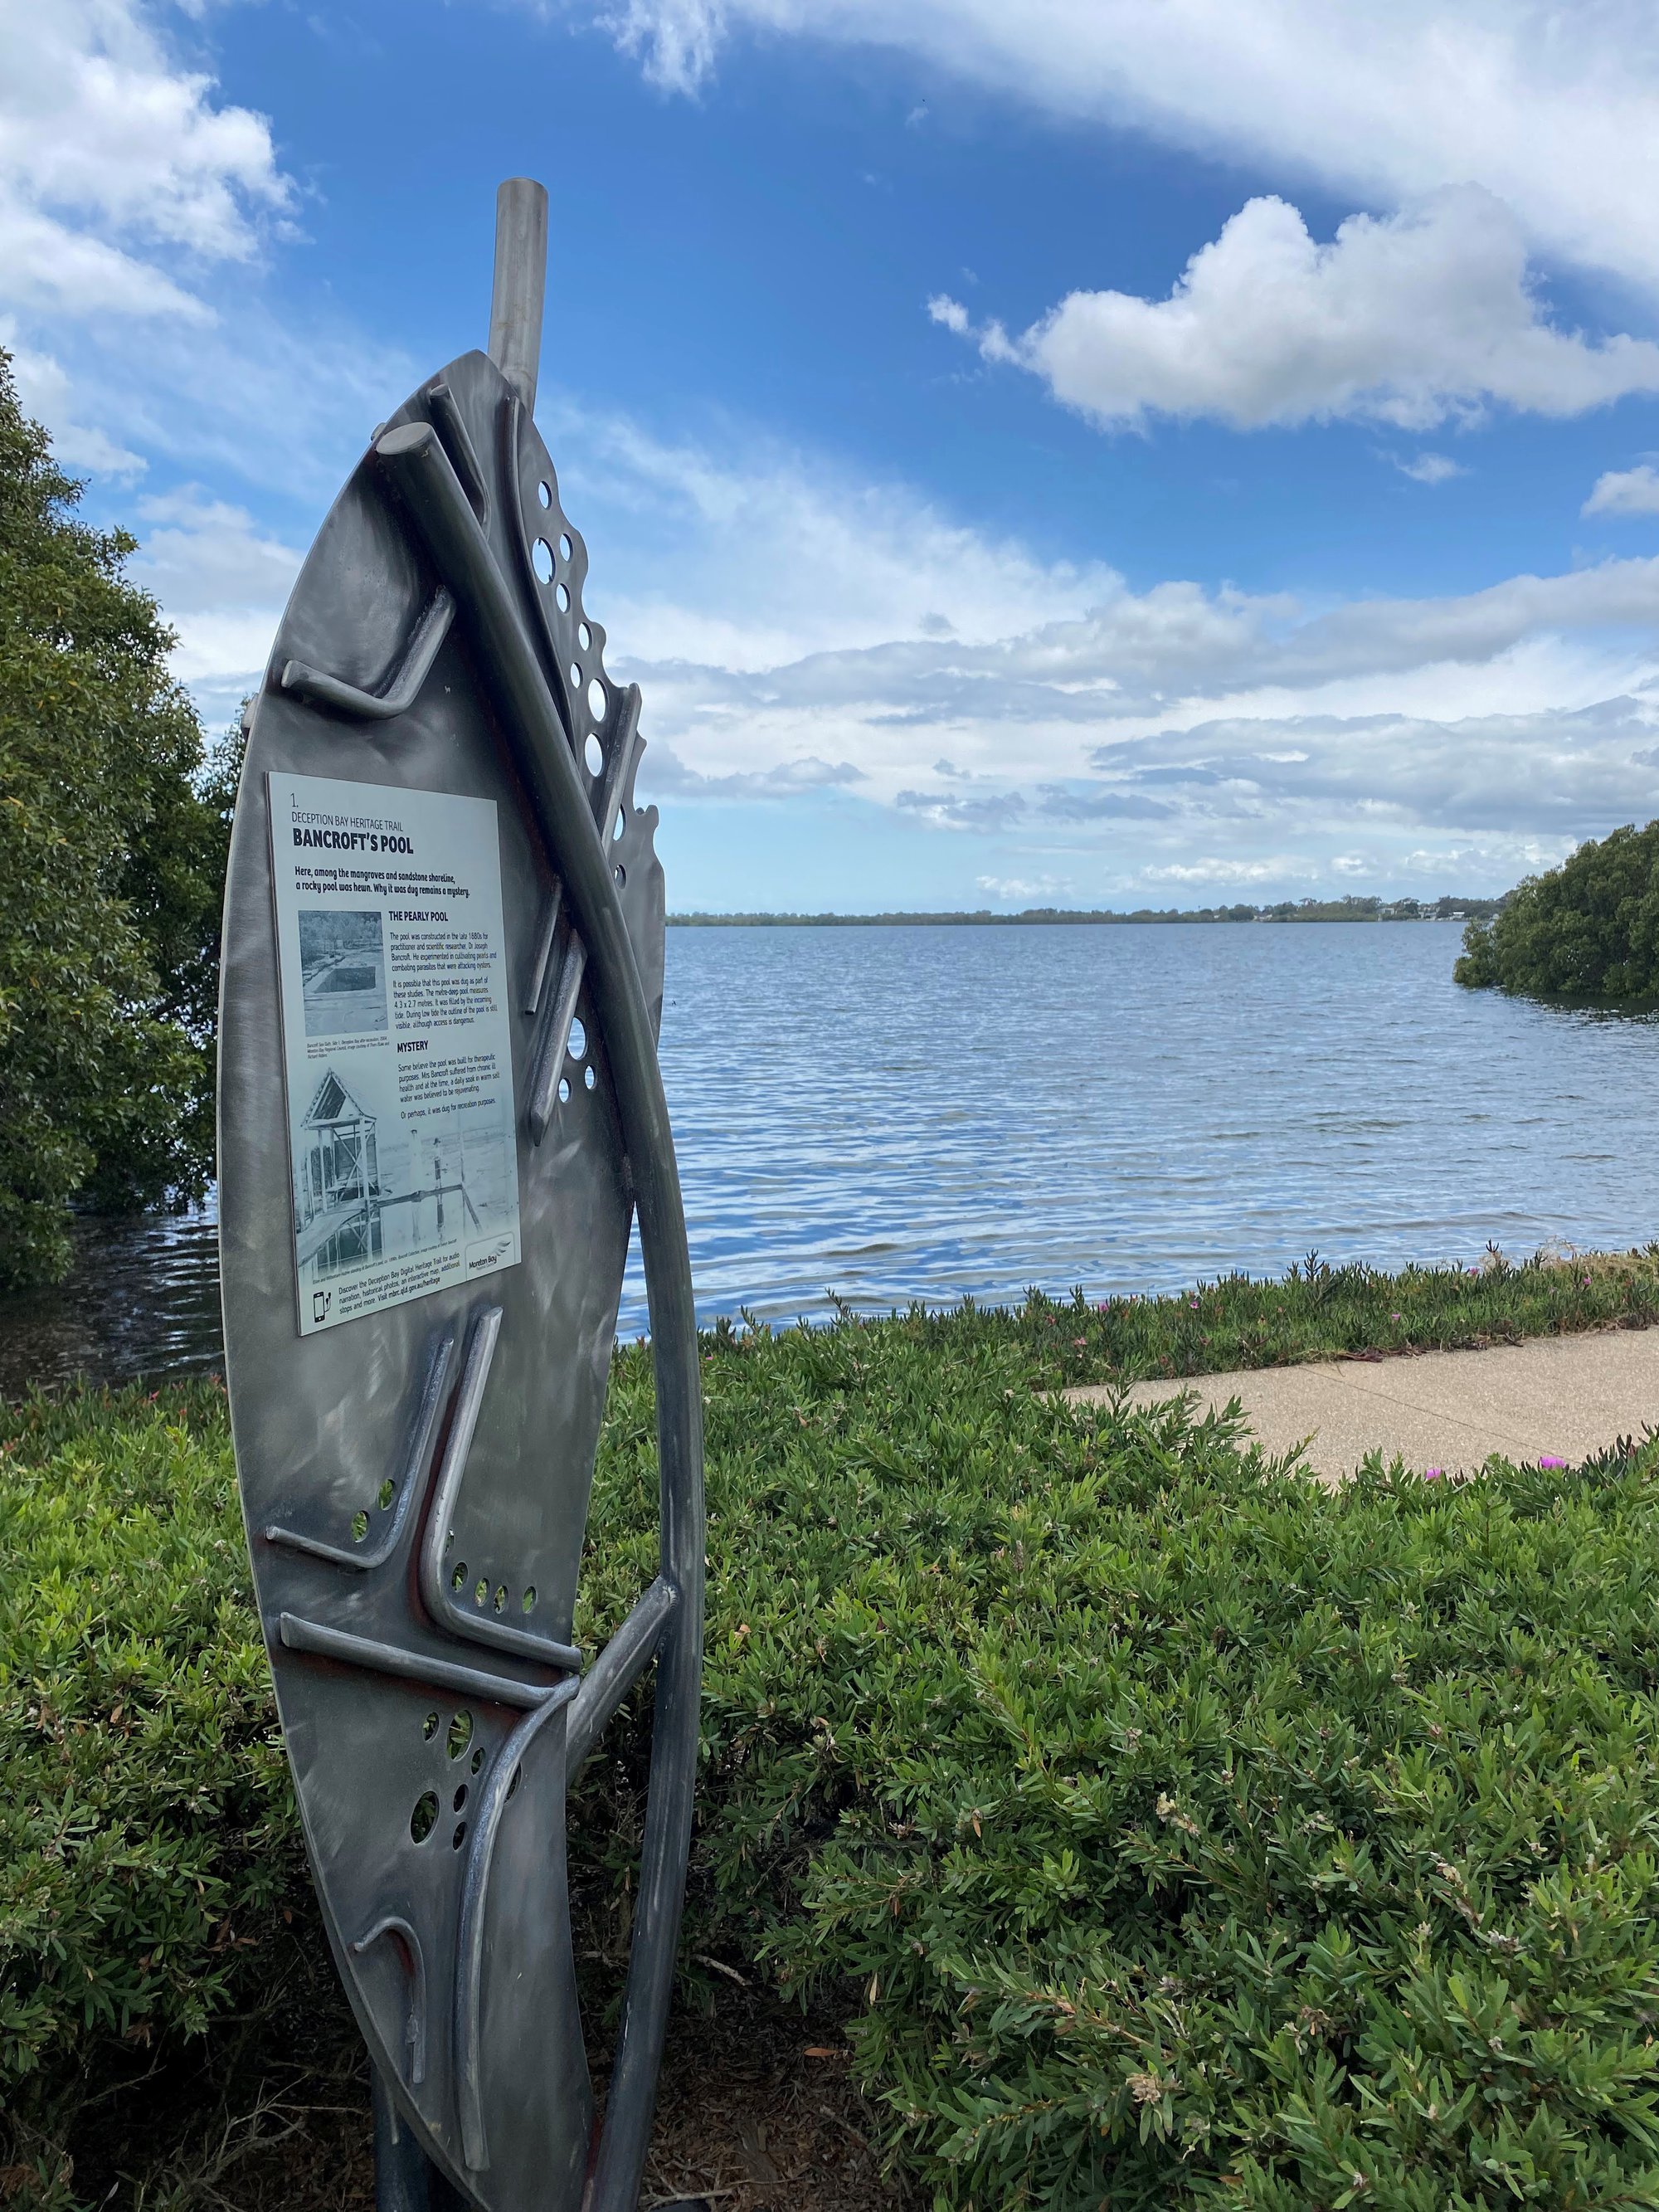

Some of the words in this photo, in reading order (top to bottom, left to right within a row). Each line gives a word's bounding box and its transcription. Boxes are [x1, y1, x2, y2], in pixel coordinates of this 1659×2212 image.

[290, 792, 299, 808] 1.
[292, 811, 333, 826] DECEPTION
[335, 816, 349, 826] BAY
[350, 817, 383, 830] HERITAGE
[384, 821, 403, 831] TRAIL
[293, 828, 378, 851] BANCROFT'S
[381, 836, 414, 854] POOL
[295, 866, 313, 878] Here,
[314, 869, 337, 880] among
[338, 868, 349, 878] the
[350, 870, 385, 882] mangroves
[386, 871, 397, 880] and
[398, 872, 427, 881] sandstone
[429, 873, 455, 884] shoreline,
[296, 882, 301, 890] a
[302, 880, 321, 894] rocky
[323, 881, 338, 894] pool
[339, 884, 353, 892] was
[353, 882, 372, 893] hewn.
[373, 884, 387, 896] Why
[388, 884, 393, 894] it
[394, 885, 406, 894] was
[407, 884, 419, 897] dug
[419, 885, 441, 895] remains
[447, 887, 470, 899] mystery.
[389, 911, 403, 921] THE
[404, 911, 430, 921] PEARLY
[431, 911, 449, 922] POOL
[390, 932, 399, 940] The
[400, 933, 410, 942] pool
[460, 932, 468, 940] late
[391, 943, 416, 953] practitioner
[426, 942, 445, 950] scientific
[412, 953, 420, 961] He
[421, 952, 449, 962] experimented
[455, 952, 476, 961] cultivating
[392, 962, 416, 972] combating
[416, 962, 436, 972] parasites
[458, 962, 476, 971] attacking
[392, 980, 397, 988] It
[402, 979, 421, 989] possible
[421, 978, 431, 987] that
[431, 978, 440, 987] this
[440, 978, 450, 987] pool
[460, 977, 469, 987] dug
[475, 977, 484, 986] part
[484, 976, 489, 984] of
[426, 988, 435, 996] The
[435, 988, 459, 996] metre-deep
[460, 987, 469, 996] pool
[394, 1001, 403, 1009] 4.3
[407, 1000, 416, 1008] 2.7
[435, 998, 439, 1006] It
[460, 997, 465, 1006] by
[474, 996, 492, 1005] incoming
[406, 1010, 421, 1020] During
[448, 1007, 463, 1016] outline
[475, 1006, 485, 1015] pool
[489, 1004, 498, 1012] still
[412, 1020, 432, 1029] although
[397, 1040, 429, 1053] MYSTERY
[398, 1064, 411, 1072] Some
[412, 1062, 429, 1070] believe
[429, 1060, 437, 1069] the
[437, 1059, 447, 1069] pool
[457, 1056, 466, 1065] built
[474, 1053, 495, 1062] therapeutic
[431, 1068, 449, 1079] Bancroft
[450, 1067, 466, 1075] suffered
[399, 1084, 415, 1092] health
[415, 1082, 424, 1090] and
[424, 1081, 430, 1089] at
[455, 1076, 465, 1085] daily
[465, 1074, 475, 1083] soak
[400, 1094, 413, 1103] water
[423, 1089, 442, 1099] believed
[401, 1111, 406, 1119] Or
[427, 1107, 431, 1115] it
[441, 1104, 450, 1113] dug
[457, 1100, 477, 1109] recreation
[469, 1258, 487, 1269] Moreton
[488, 1255, 497, 1264] Bay
[338, 1284, 358, 1294] Discover
[359, 1280, 367, 1289] the
[367, 1274, 390, 1286] Deception
[391, 1271, 399, 1279] Bay
[400, 1265, 414, 1277] Digital
[415, 1260, 432, 1271] Heritage
[433, 1257, 442, 1265] Trail
[449, 1252, 460, 1261] audio
[338, 1293, 361, 1304] narration,
[362, 1283, 383, 1297] historical
[384, 1279, 400, 1291] photos,
[407, 1271, 429, 1283] interactive
[440, 1260, 460, 1272] additional
[339, 1305, 353, 1314] stops
[353, 1301, 362, 1310] and
[377, 1293, 387, 1302] Visit
